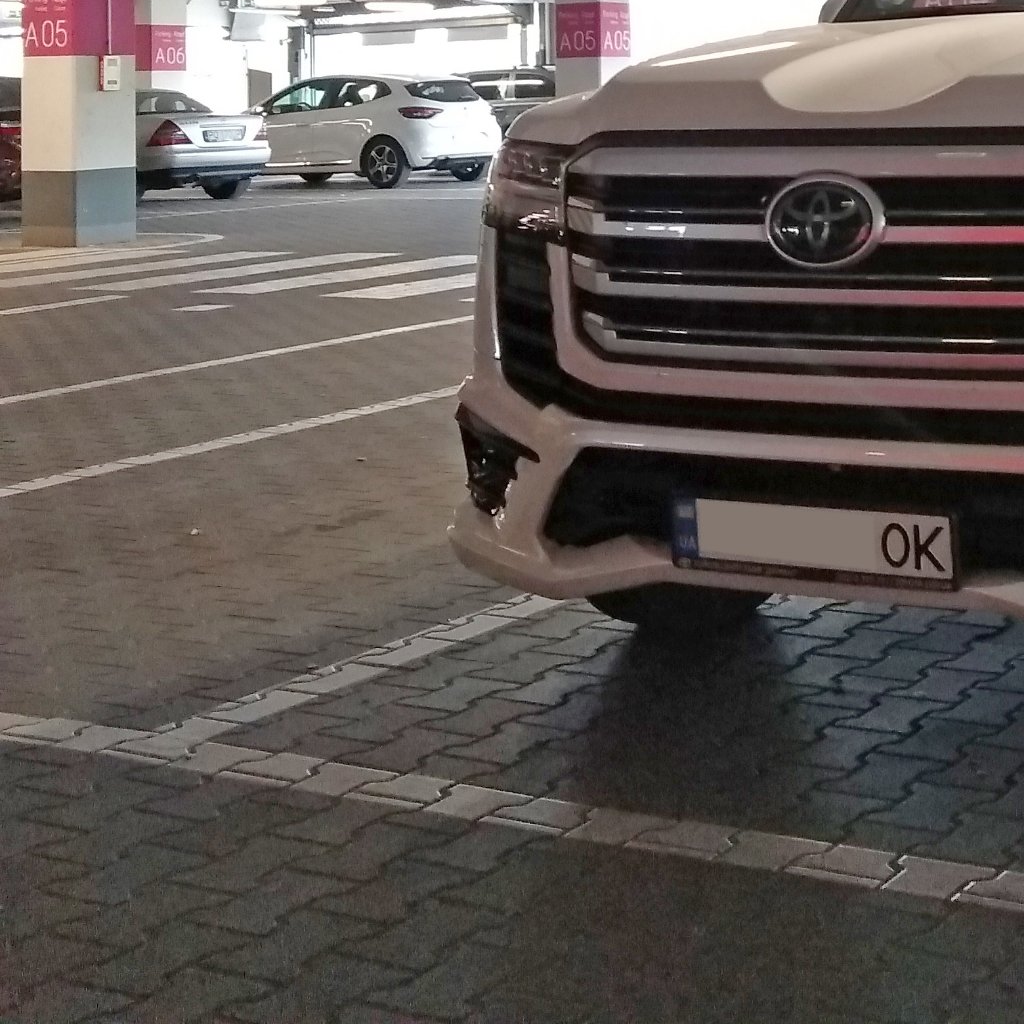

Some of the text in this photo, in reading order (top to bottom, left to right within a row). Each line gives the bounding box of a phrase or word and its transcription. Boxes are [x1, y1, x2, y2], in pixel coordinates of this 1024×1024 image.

[560, 30, 596, 51] A05
[603, 30, 630, 51] A05
[155, 47, 185, 64] A06
[881, 522, 946, 573] OK
